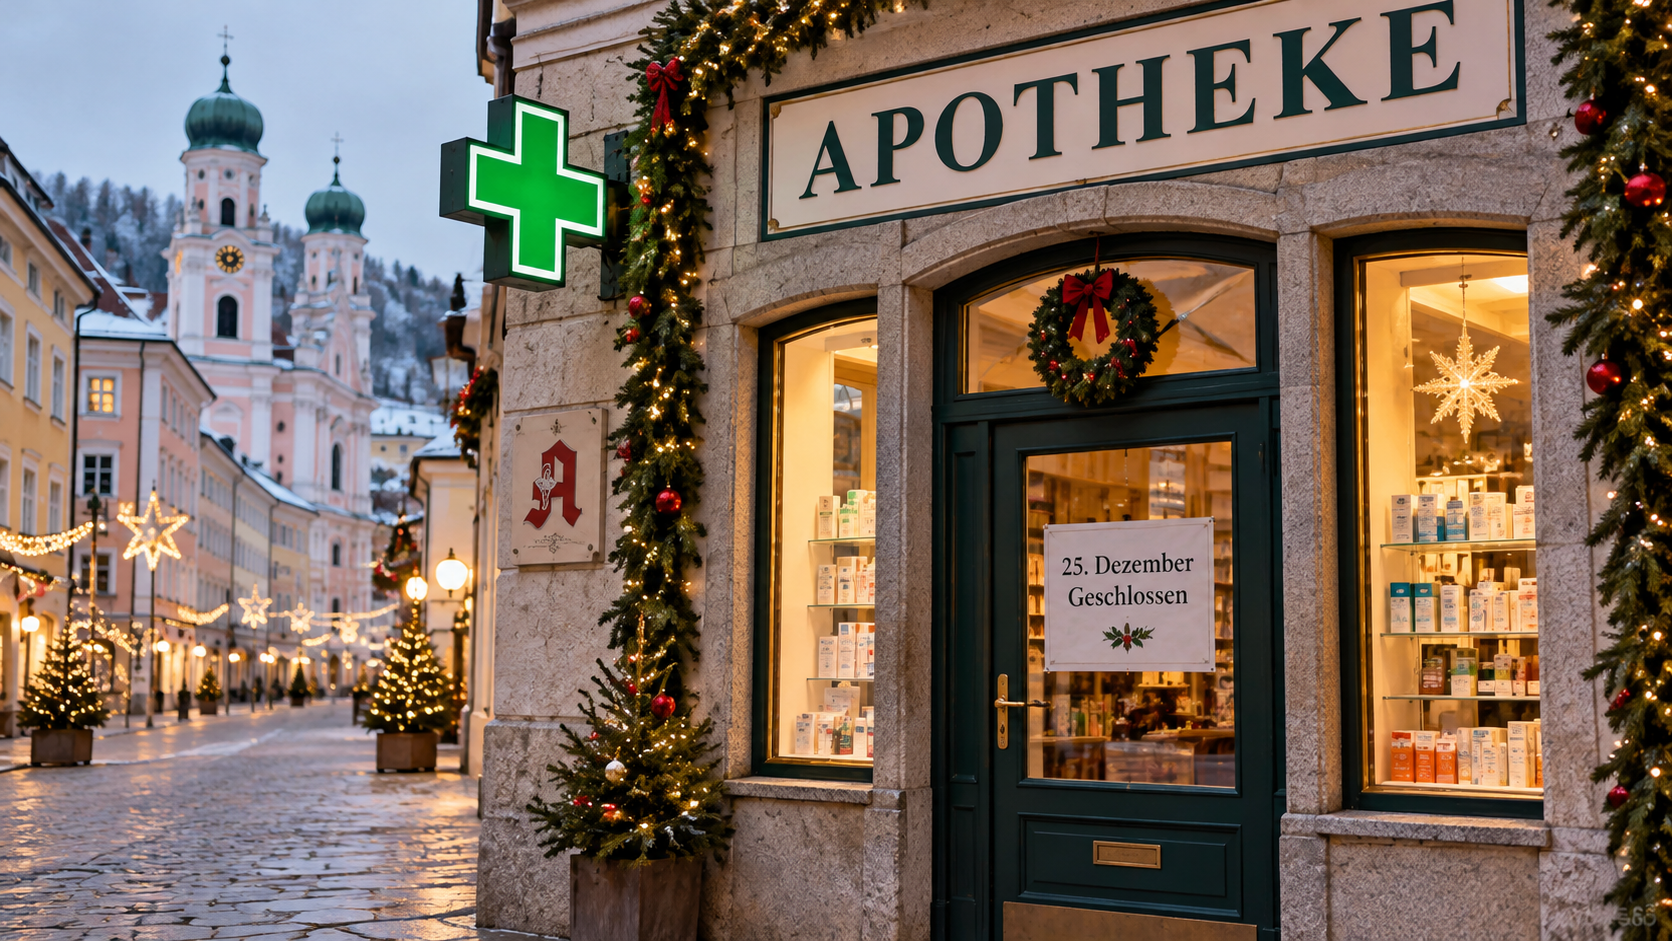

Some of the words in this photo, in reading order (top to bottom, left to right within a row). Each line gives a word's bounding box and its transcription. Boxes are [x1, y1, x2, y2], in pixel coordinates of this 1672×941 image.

[799, 0, 1461, 200] APOTHEKE
[523, 439, 583, 530] A
[1062, 556, 1089, 576] 25.
[1094, 552, 1194, 575] Dezember
[1068, 584, 1188, 607] Geschlossen
